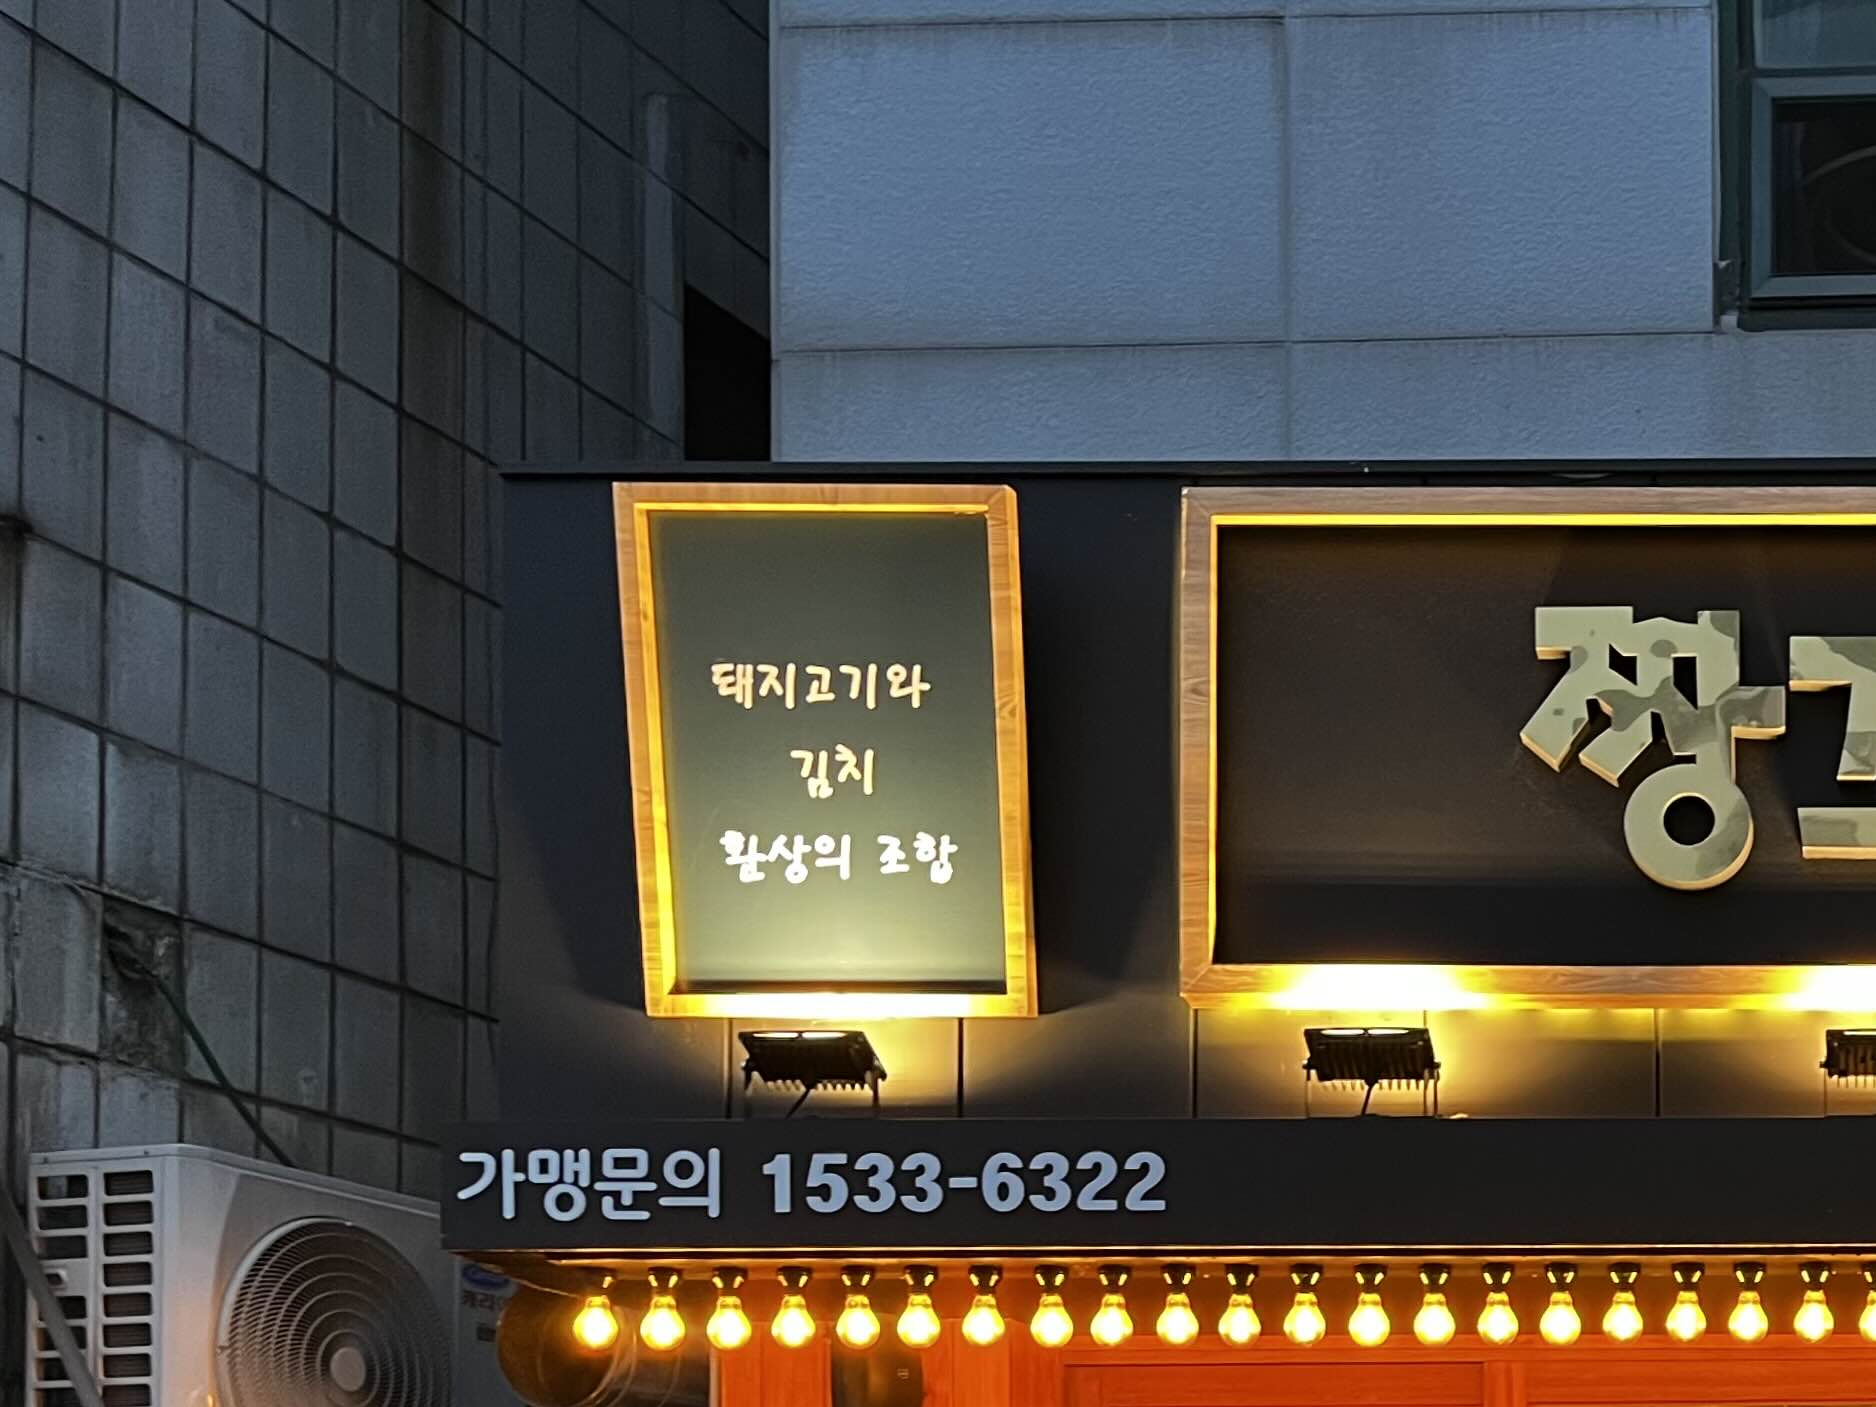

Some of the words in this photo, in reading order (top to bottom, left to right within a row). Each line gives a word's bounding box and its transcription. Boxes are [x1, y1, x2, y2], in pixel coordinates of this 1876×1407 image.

[711, 662, 931, 710] 돼지고기와
[790, 743, 875, 799] 김치
[719, 829, 852, 884] 환상의
[877, 830, 958, 884] 조합
[456, 1146, 721, 1223] 가맹문의
[761, 1150, 1168, 1215] 1533-6322
